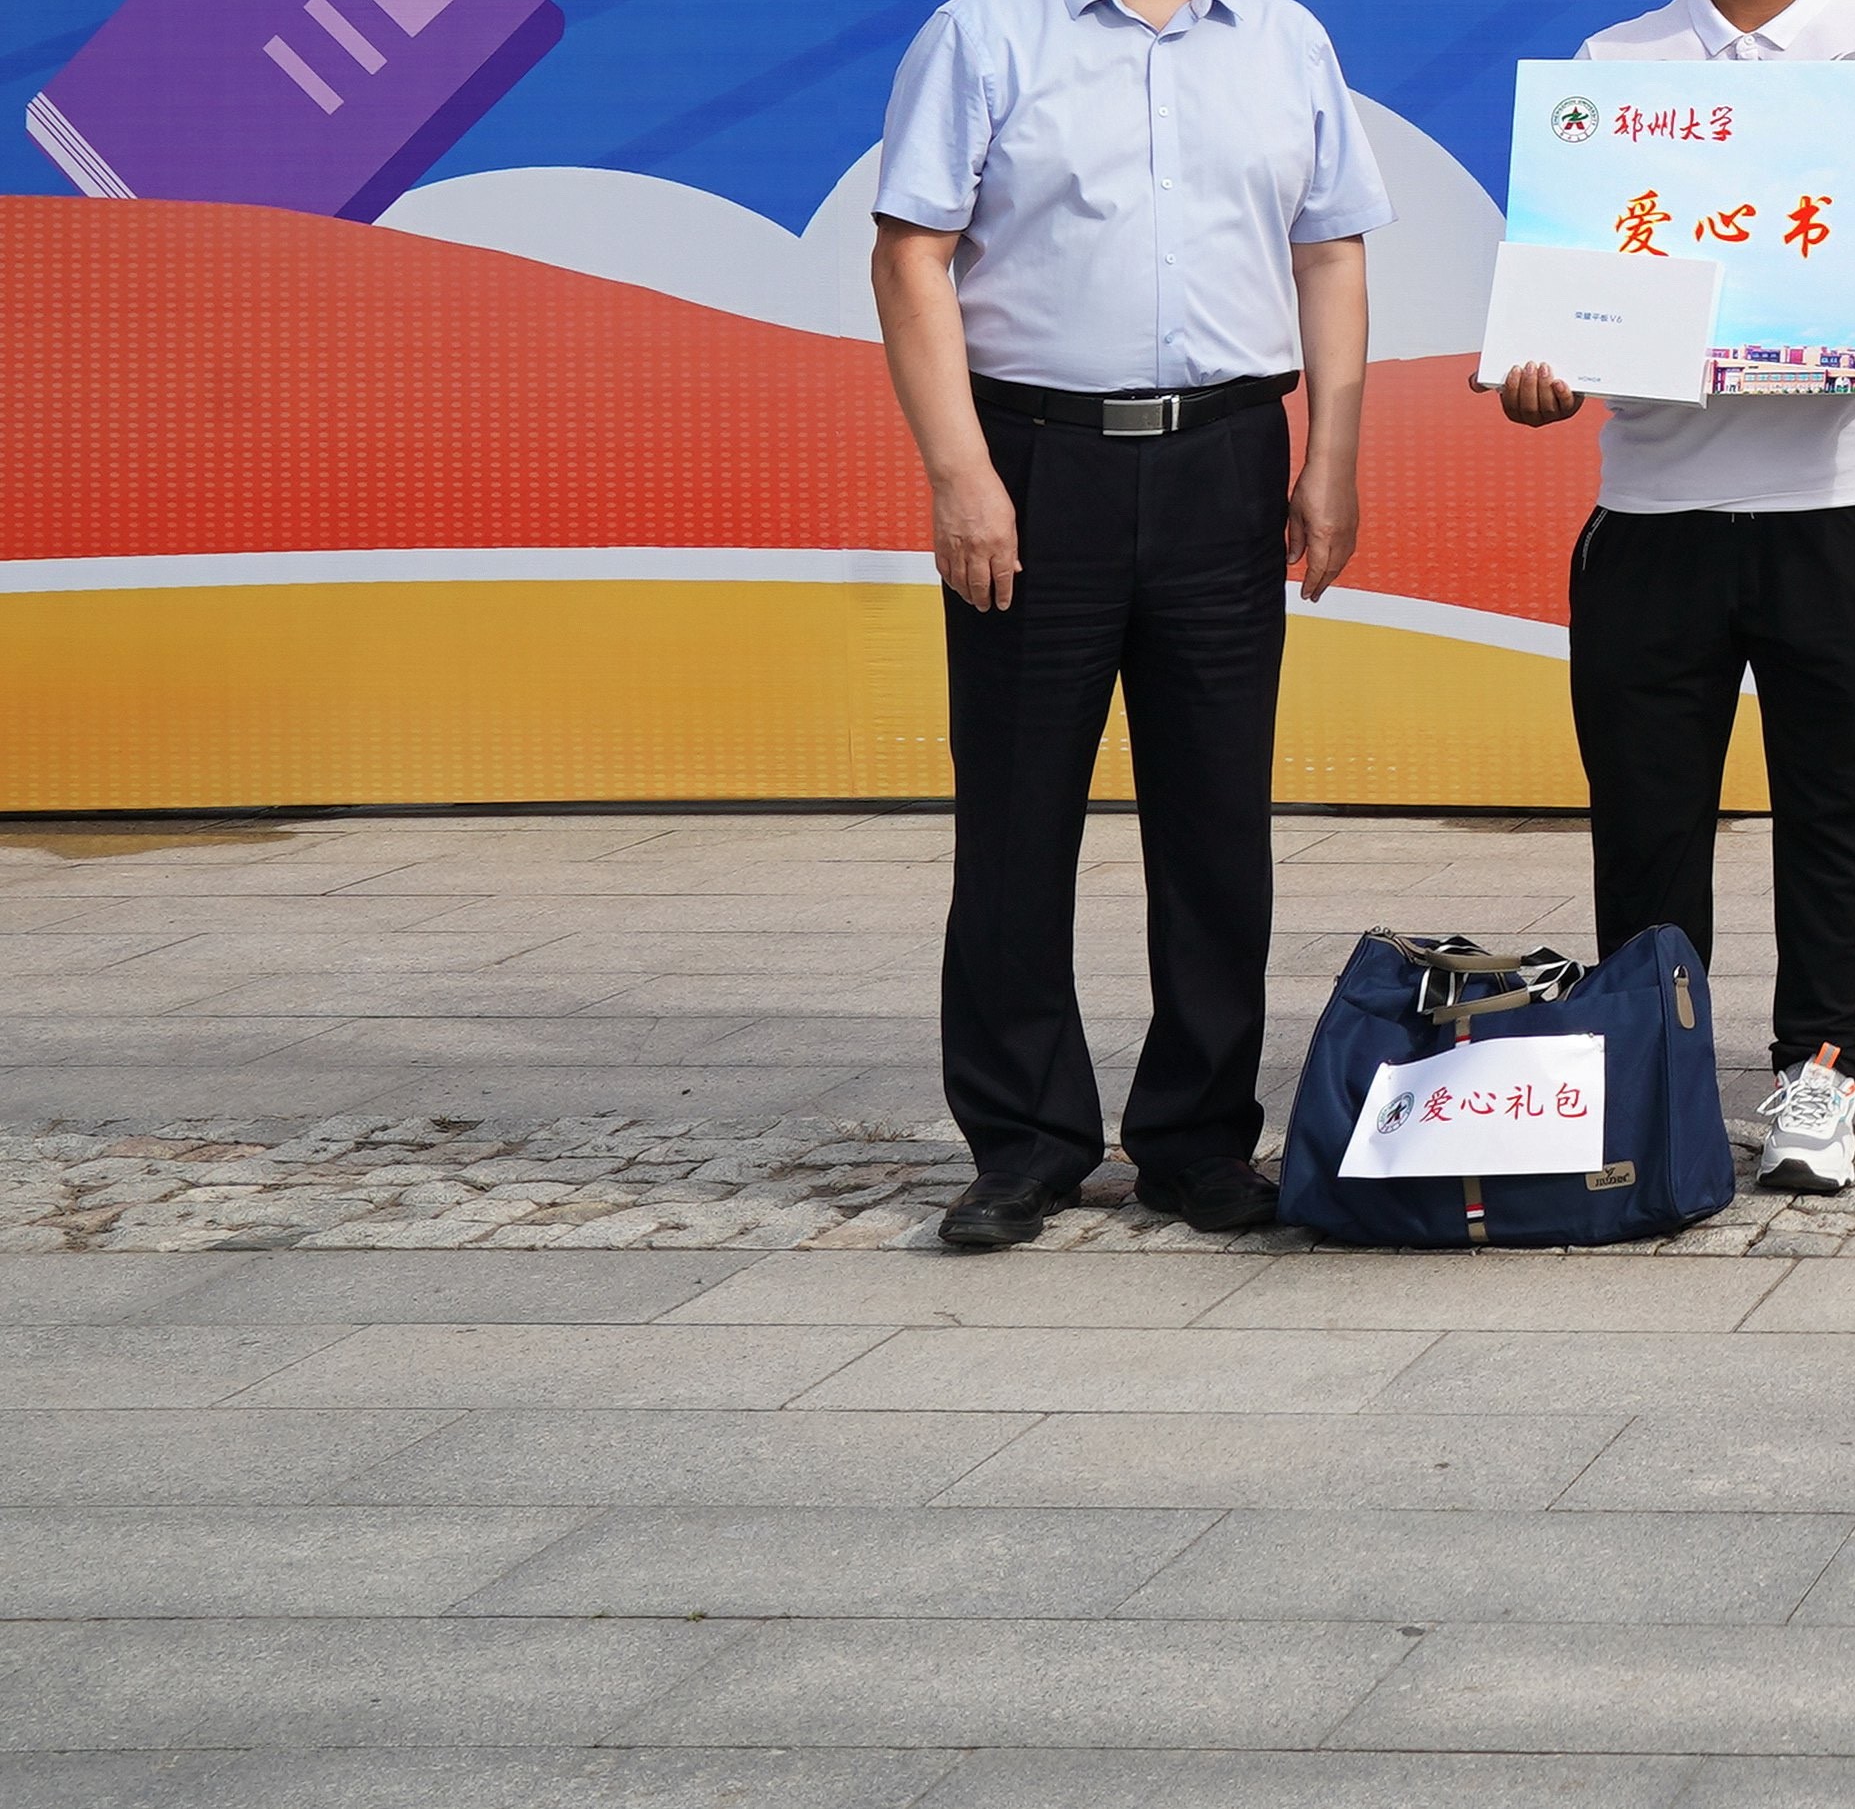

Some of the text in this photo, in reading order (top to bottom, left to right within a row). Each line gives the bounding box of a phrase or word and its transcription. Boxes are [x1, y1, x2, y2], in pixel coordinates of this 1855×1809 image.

[1613, 104, 1734, 143] 郑州大学
[1418, 1082, 1588, 1125] 爱心礼包
